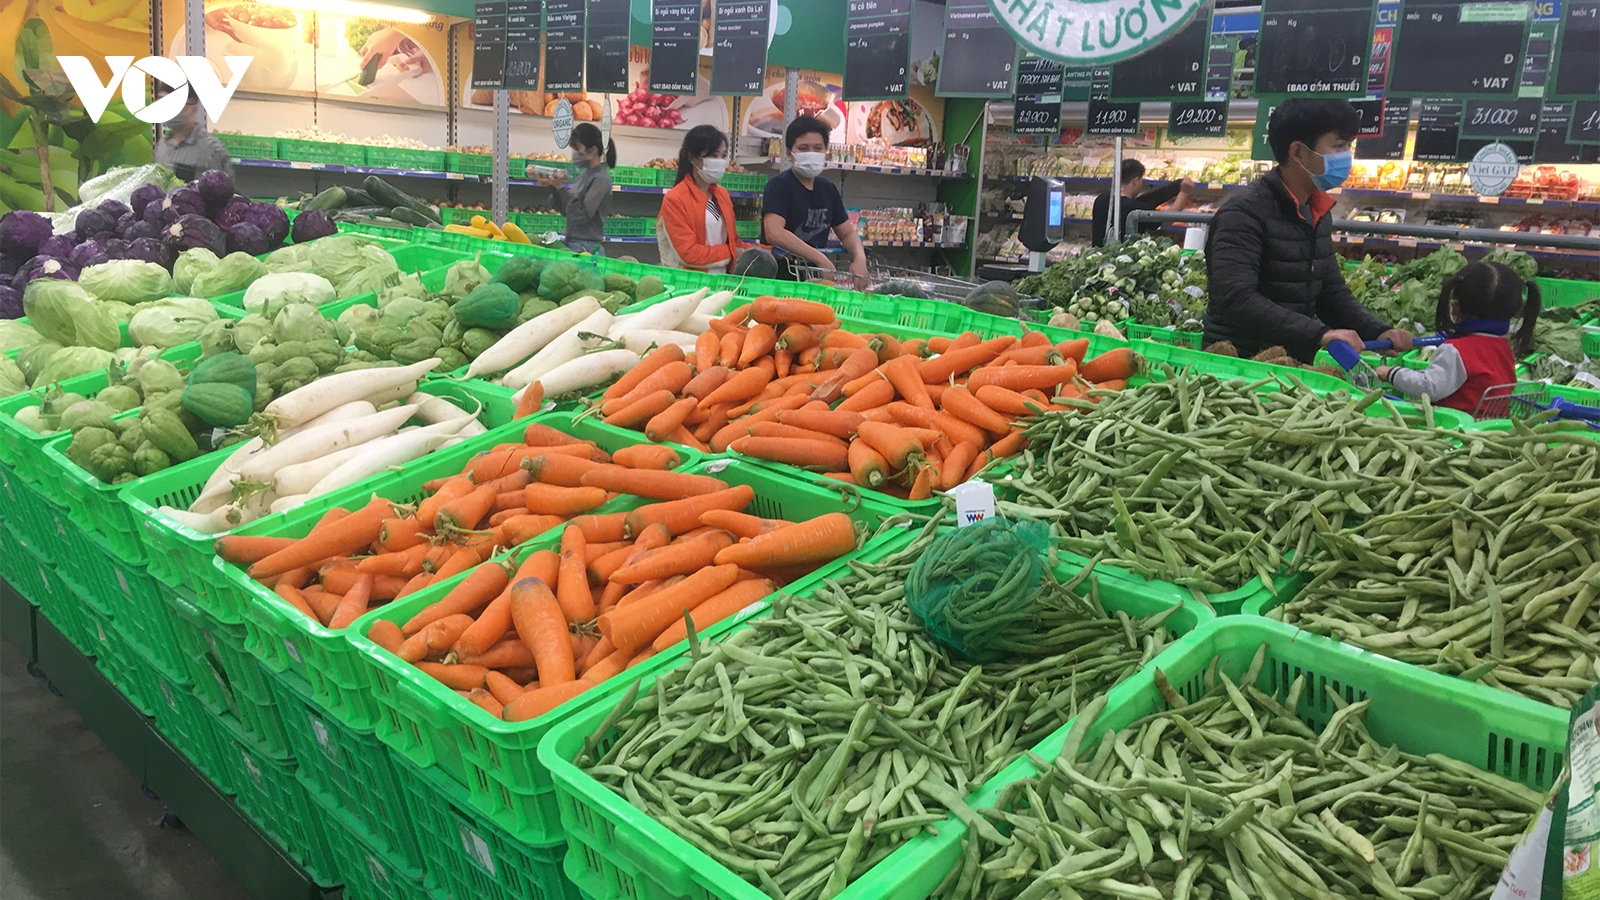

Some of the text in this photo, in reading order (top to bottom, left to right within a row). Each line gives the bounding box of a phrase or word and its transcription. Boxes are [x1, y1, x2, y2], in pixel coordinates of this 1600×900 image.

[1288, 18, 1298, 28] Kg
[992, 81, 1008, 90] VAT
[1178, 82, 1197, 92] VAT
[1287, 84, 1308, 92] (BAO
[1333, 80, 1360, 92] THUẾ)
[1483, 77, 1508, 88] VAT
[1176, 108, 1216, 126] 19.200
[1472, 108, 1518, 125] 31.000
[1472, 164, 1514, 176] Viet GAP
